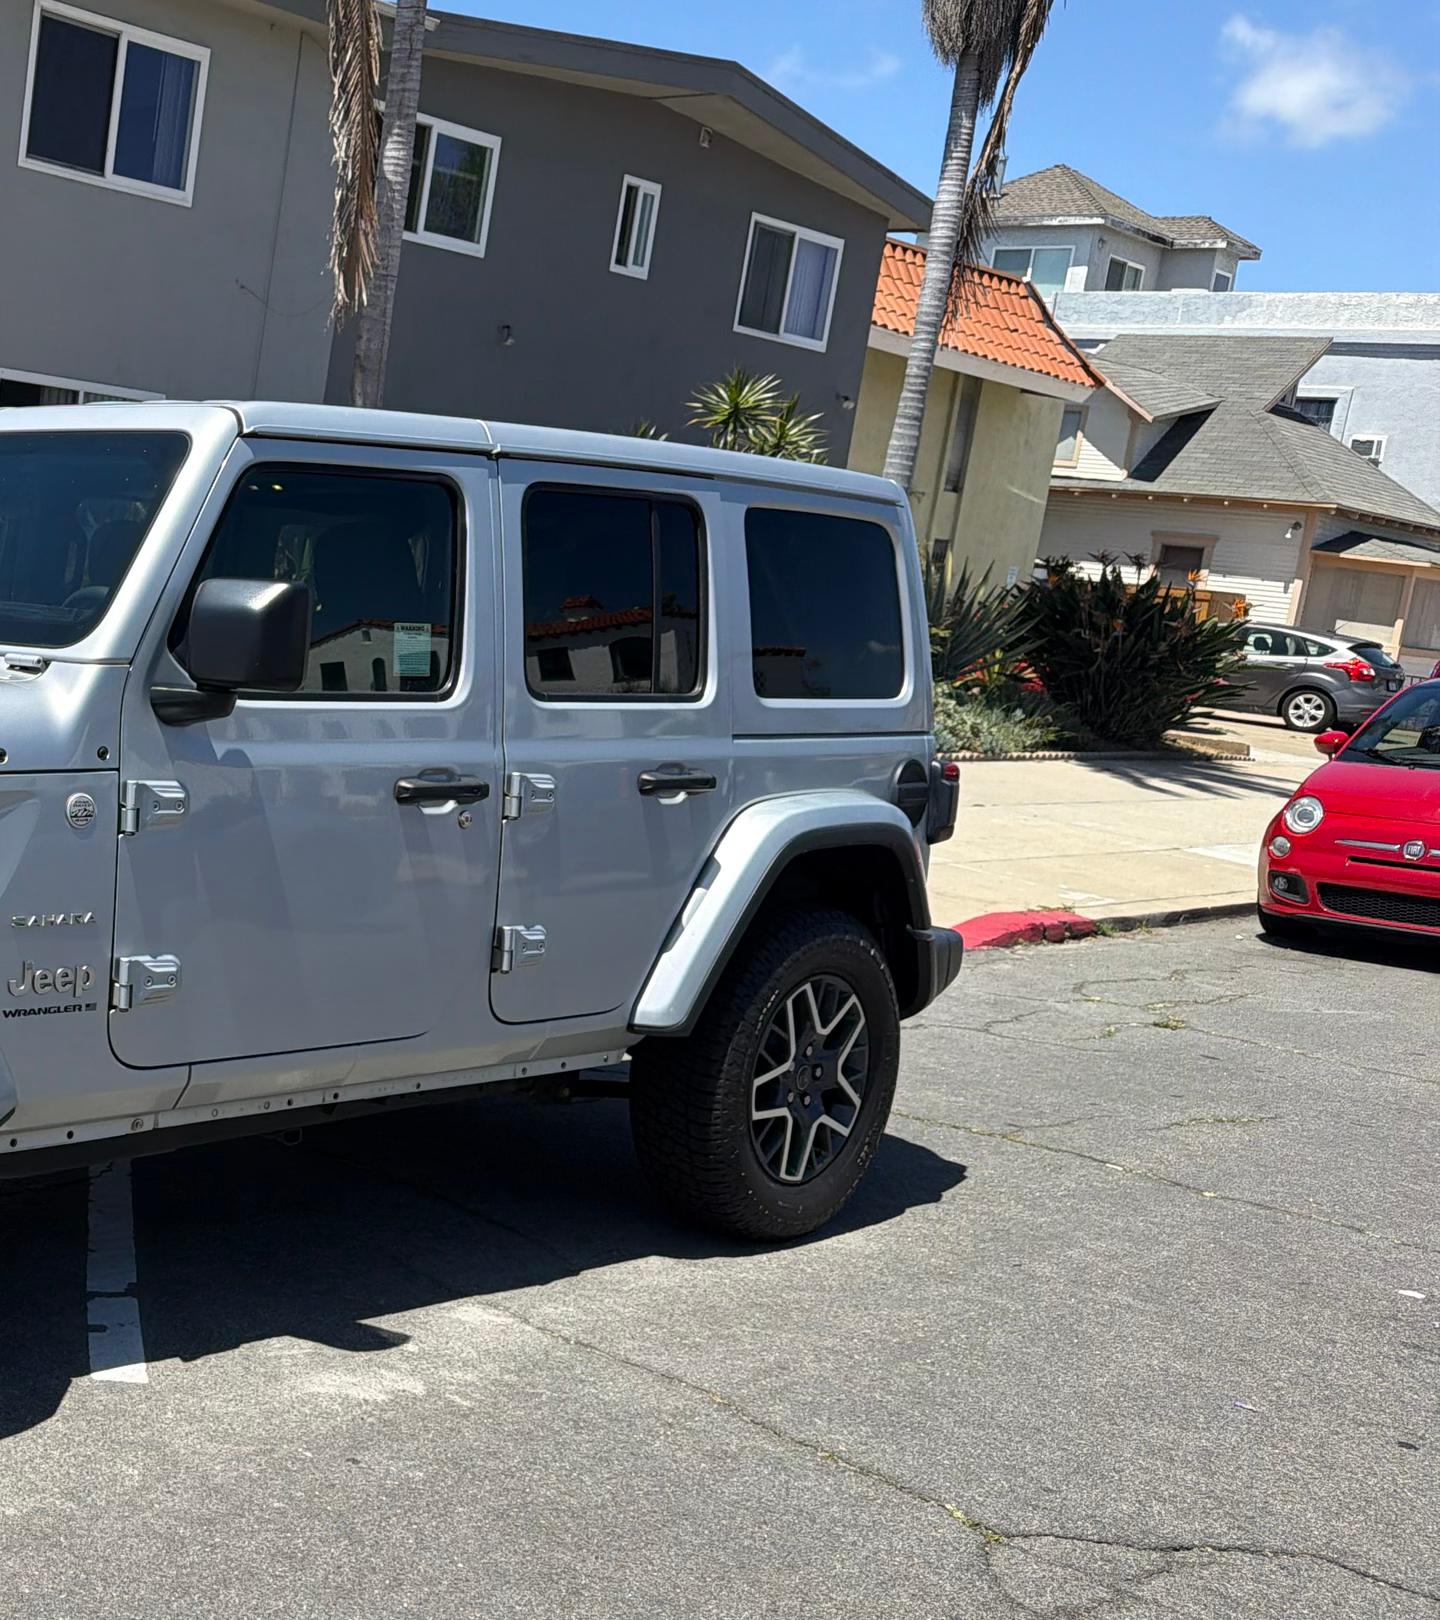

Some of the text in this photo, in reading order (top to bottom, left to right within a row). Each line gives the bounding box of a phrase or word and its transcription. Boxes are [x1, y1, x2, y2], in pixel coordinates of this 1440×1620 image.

[1407, 845, 1421, 855] FIAT
[10, 911, 97, 928] SAHARA
[7, 960, 97, 998] Jeep
[2, 1003, 83, 1019] WRANGLER
